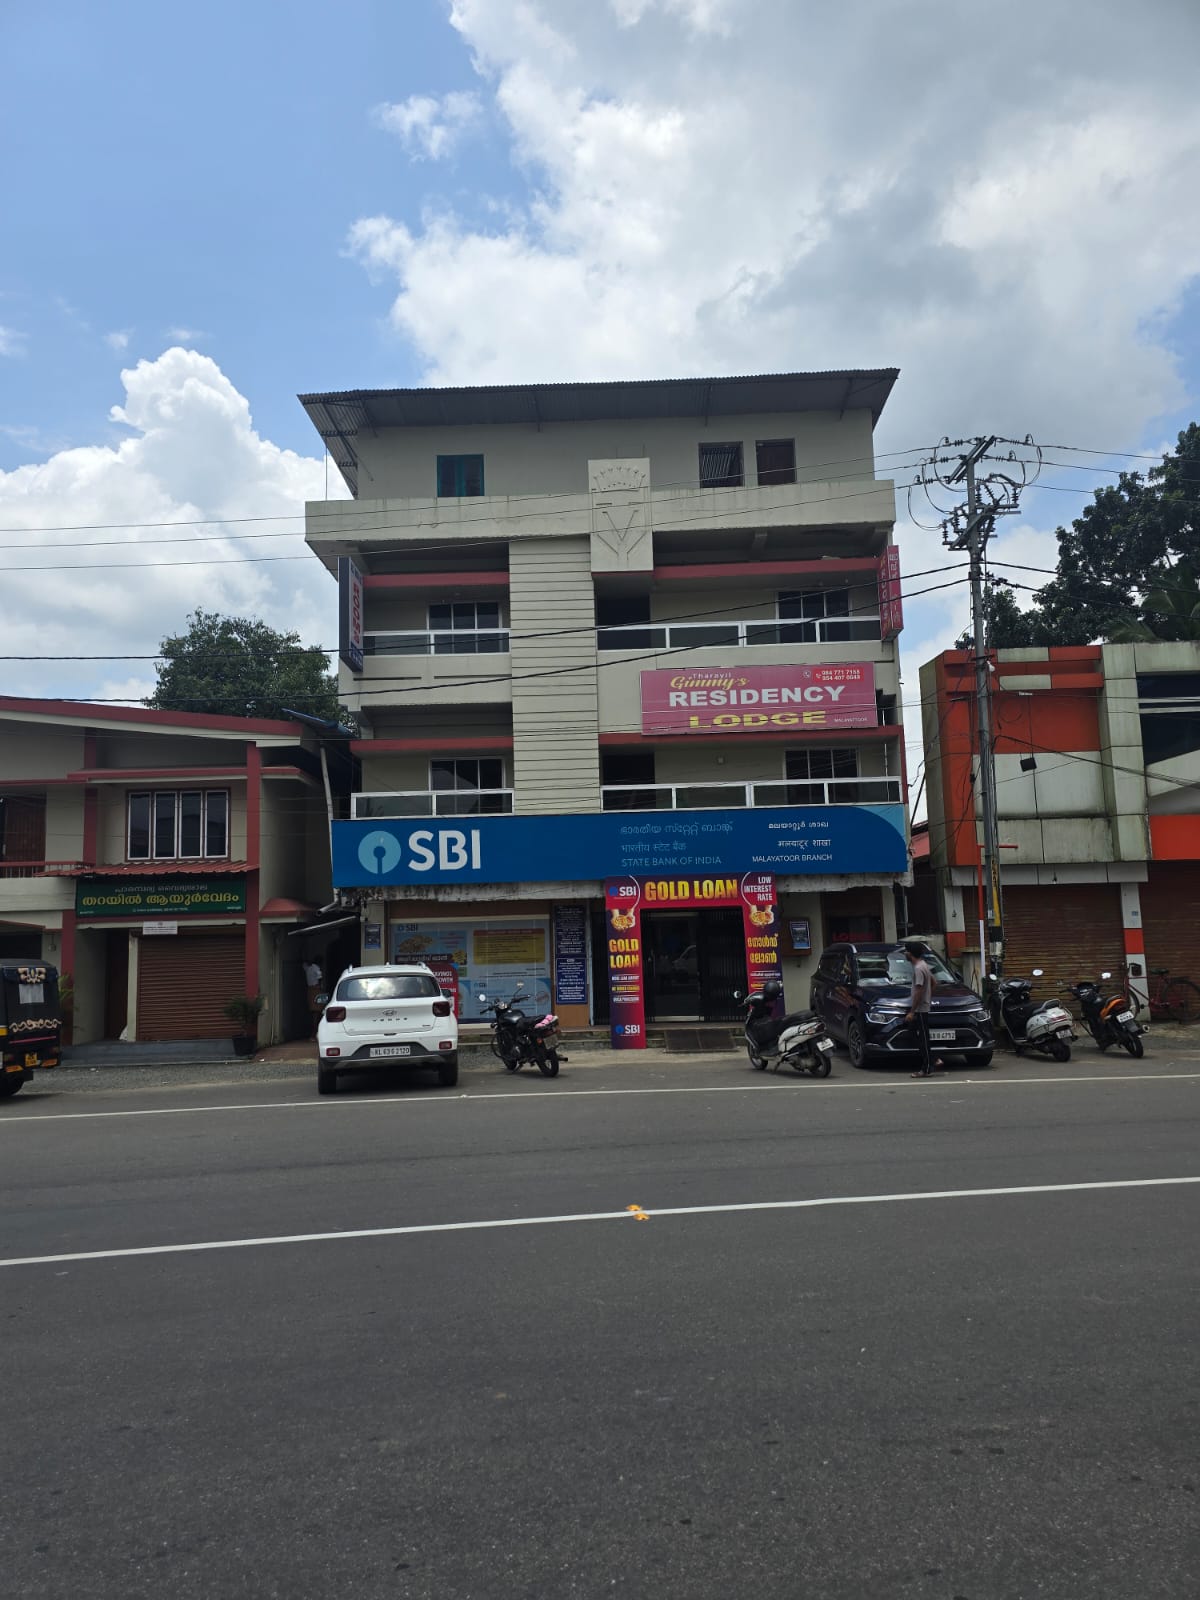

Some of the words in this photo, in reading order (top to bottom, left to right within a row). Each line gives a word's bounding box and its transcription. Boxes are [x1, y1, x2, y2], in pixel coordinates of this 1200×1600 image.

[669, 685, 845, 707] RESIDENCY
[689, 710, 827, 729] LODGE
[621, 842, 650, 853] भारतीय
[812, 839, 832, 847] शाखा
[408, 829, 481, 871] SBI
[621, 857, 650, 868] STATE
[652, 857, 678, 866] BANK
[679, 856, 693, 865] OF
[695, 856, 722, 865] INDIA
[752, 854, 800, 863] MALAYATOOR
[801, 853, 833, 862] BRANCH
[757, 876, 772, 884] LOW
[619, 885, 637, 897] SBI
[644, 880, 690, 901] GOLD
[693, 879, 738, 899] LOAN
[744, 885, 772, 893] INTEREST
[82, 893, 142, 906] തറയിൽ
[757, 893, 773, 902] RATE
[609, 939, 639, 953] GOLD
[609, 954, 640, 969] LOAN
[624, 1024, 640, 1034] SBI
